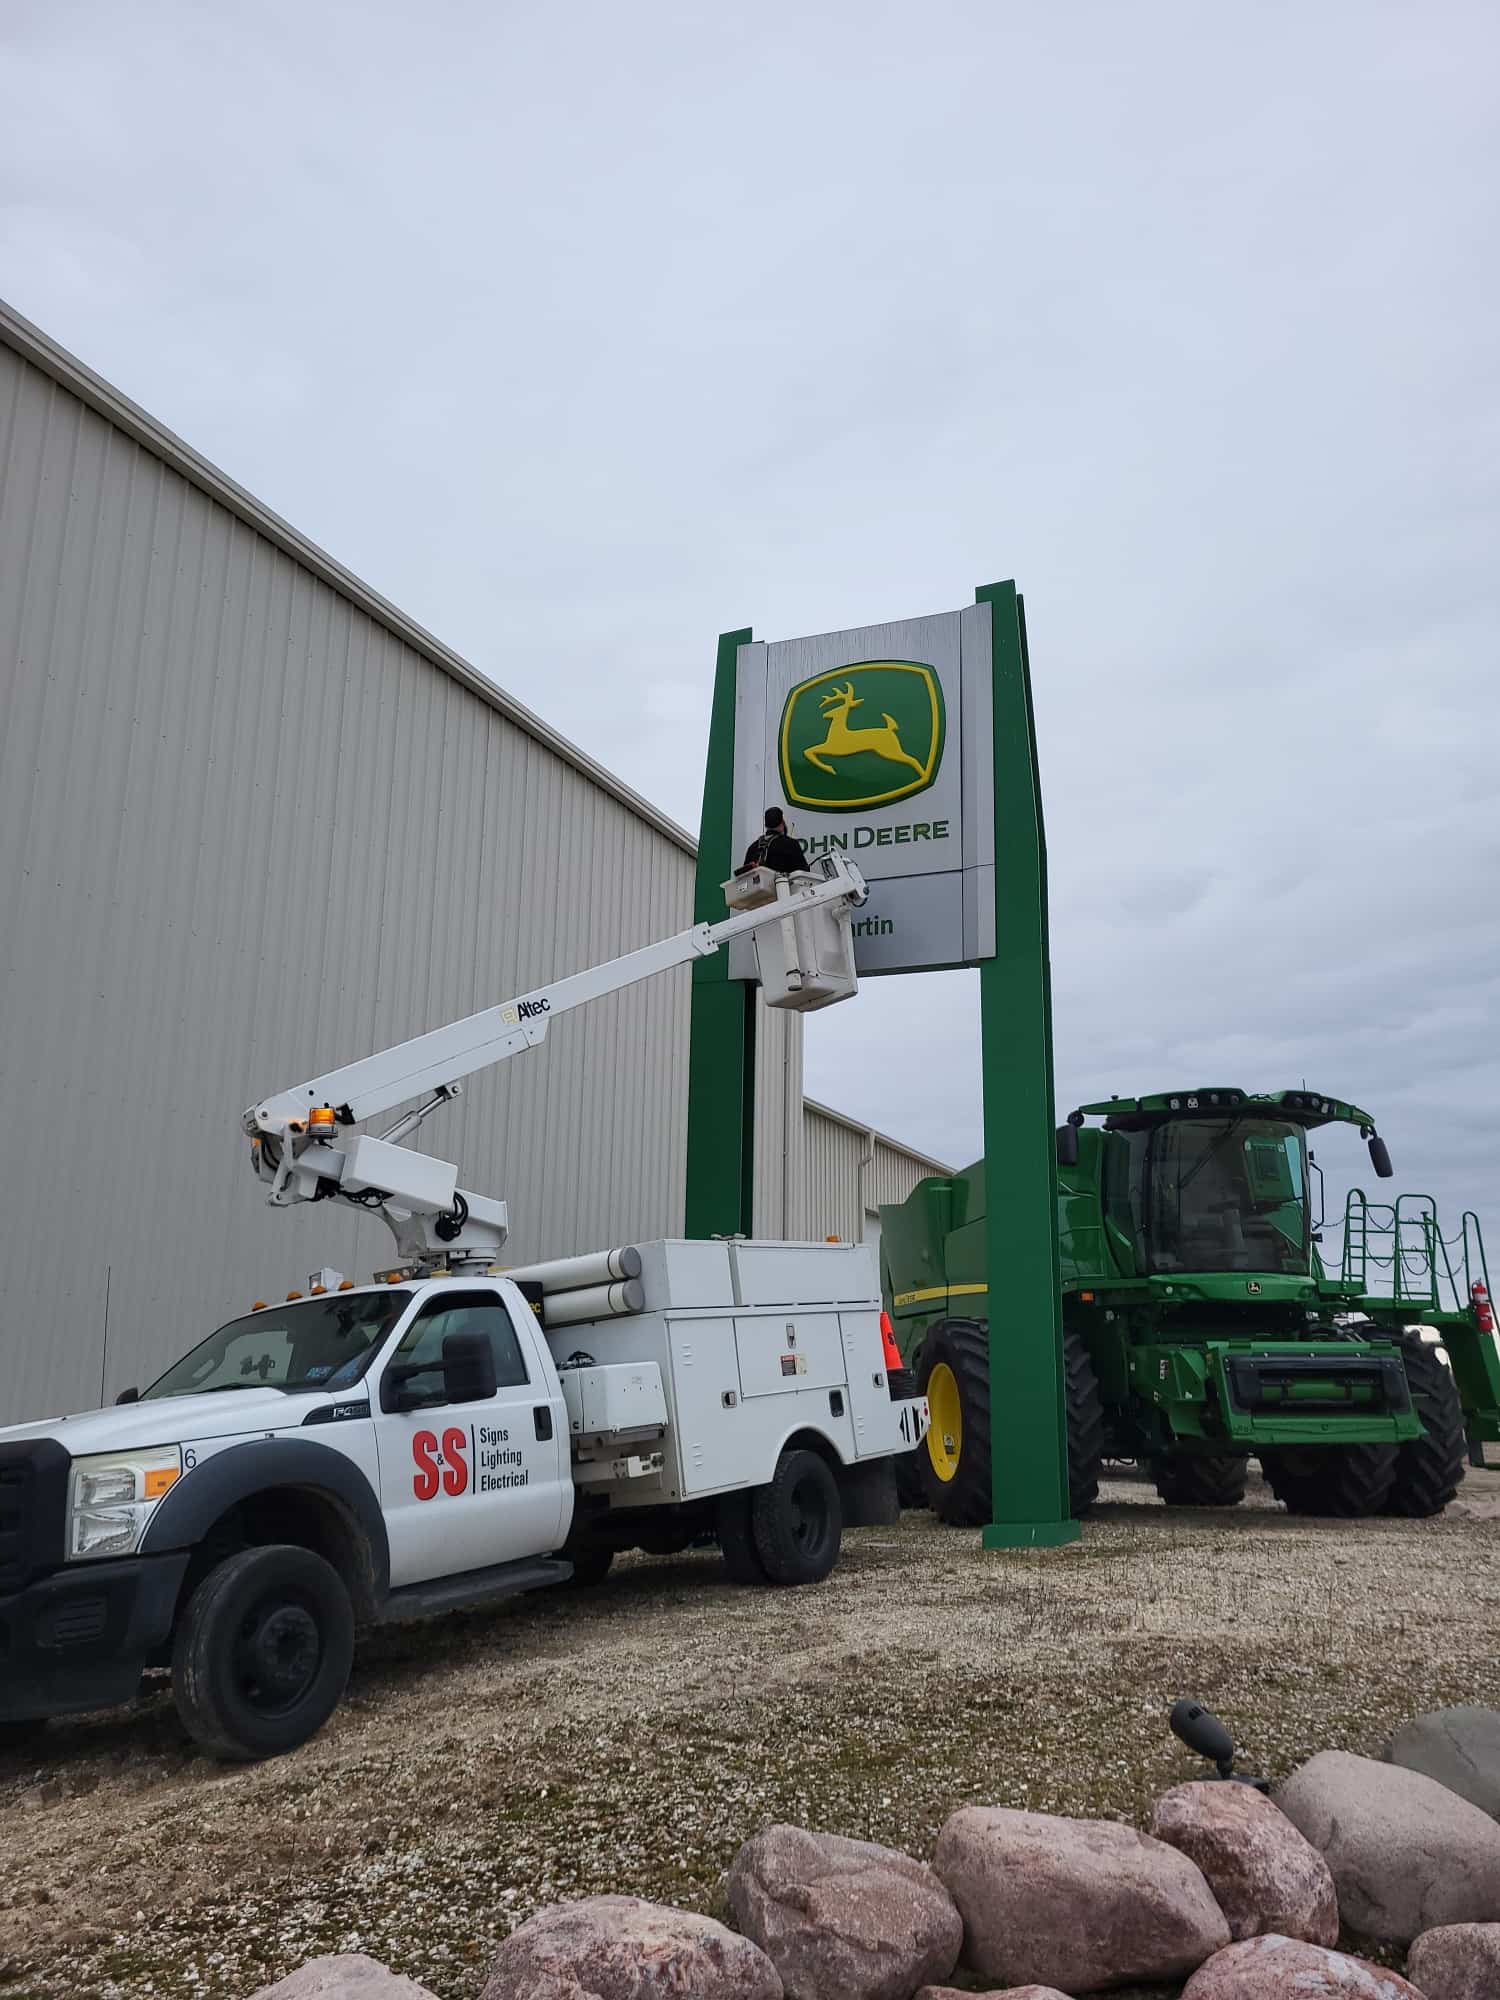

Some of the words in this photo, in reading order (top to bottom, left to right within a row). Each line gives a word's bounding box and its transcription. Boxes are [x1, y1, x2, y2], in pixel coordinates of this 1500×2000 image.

[798, 832, 848, 854] HN
[854, 820, 949, 848] DEERE
[851, 914, 894, 937] rtin
[517, 998, 551, 1021] Altec
[480, 1427, 509, 1446] Signs
[184, 1448, 197, 1469] 6
[412, 1427, 468, 1501] S&S
[481, 1448, 522, 1469] Lighting
[481, 1469, 529, 1491] Electrical
